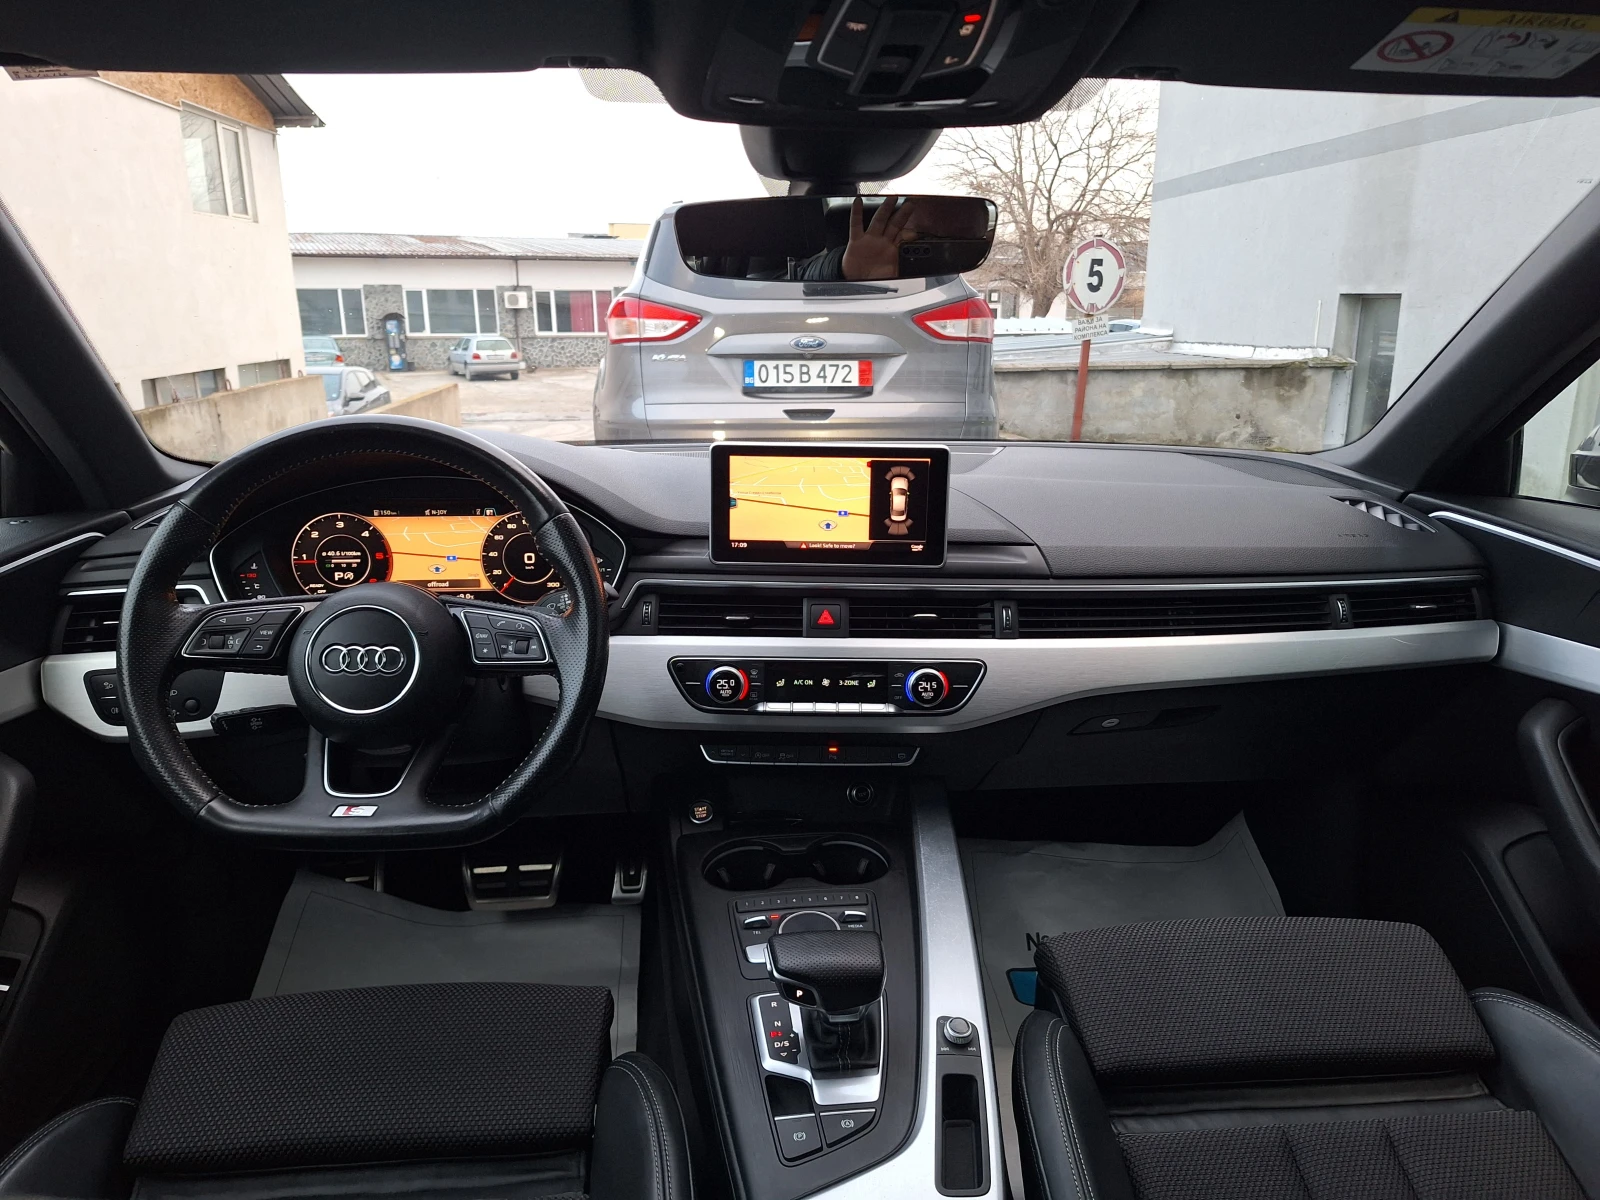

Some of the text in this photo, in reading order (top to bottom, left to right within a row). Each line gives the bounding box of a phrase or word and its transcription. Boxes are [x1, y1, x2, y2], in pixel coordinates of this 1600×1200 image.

[1496, 14, 1587, 30] AIRBAG
[1086, 258, 1104, 293] 5
[1074, 324, 1098, 333] РАЙОНА
[1073, 330, 1108, 340] КОМПЛЕКСА
[798, 338, 818, 348] Ford
[524, 552, 535, 564] 0
[334, 572, 343, 581] P
